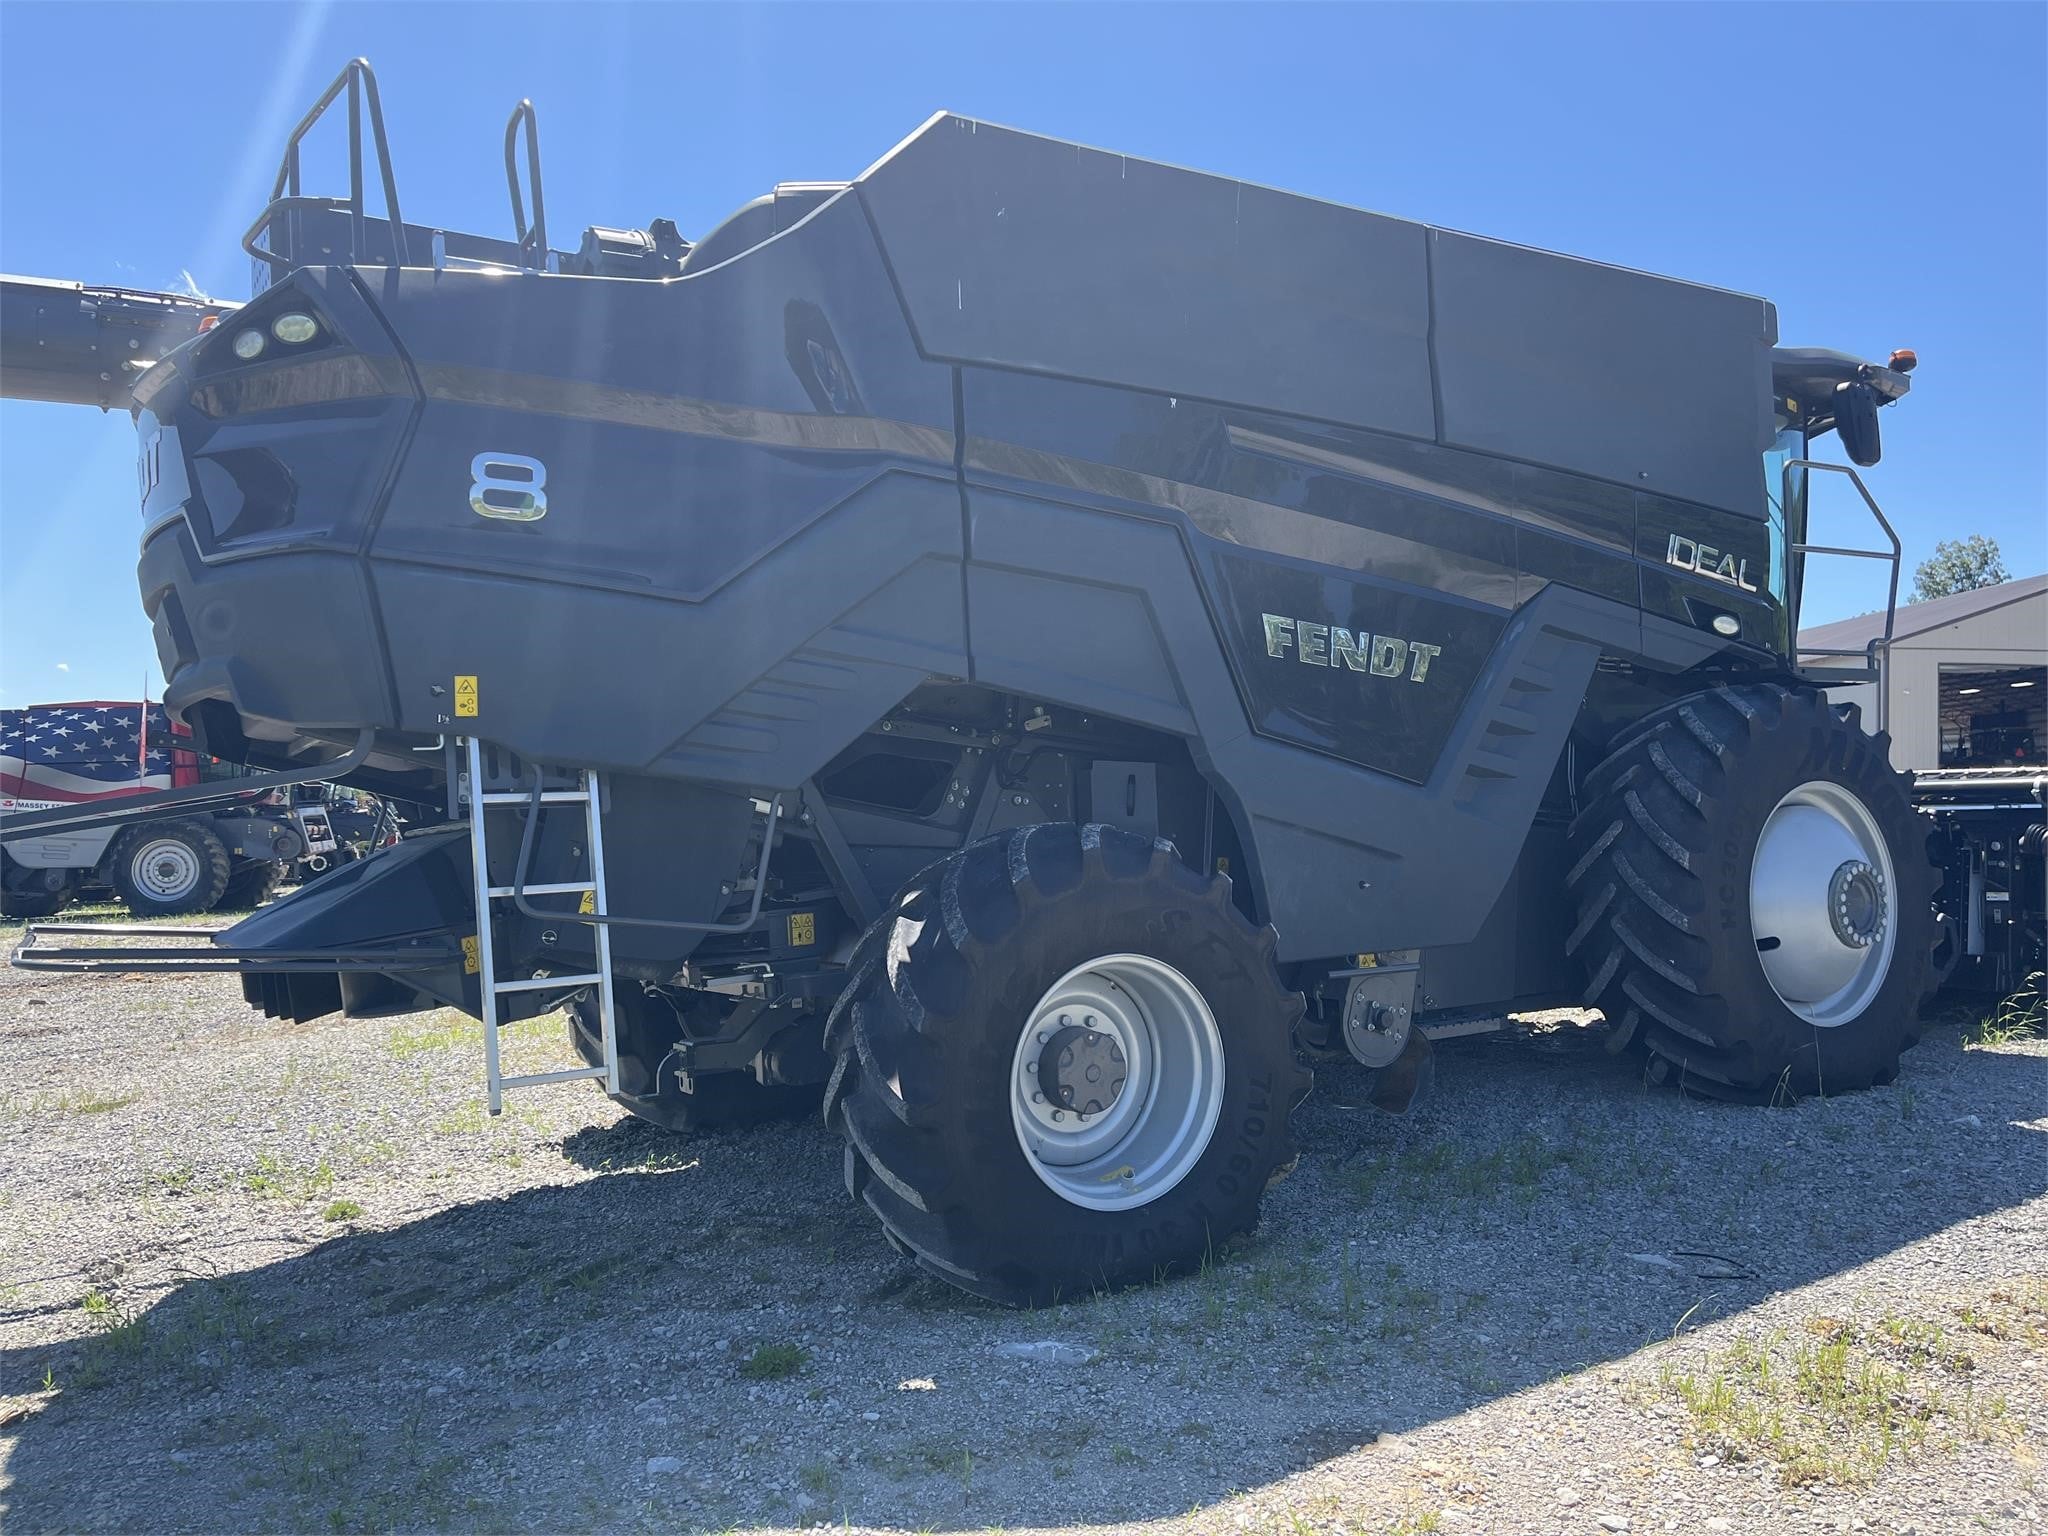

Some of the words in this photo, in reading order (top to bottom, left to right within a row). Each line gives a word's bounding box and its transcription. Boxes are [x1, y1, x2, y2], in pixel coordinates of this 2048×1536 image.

[469, 452, 547, 521] 8
[1666, 533, 1757, 593] IDEAL
[1261, 612, 1442, 683] FENDT
[1215, 1072, 1272, 1197] 710/60
